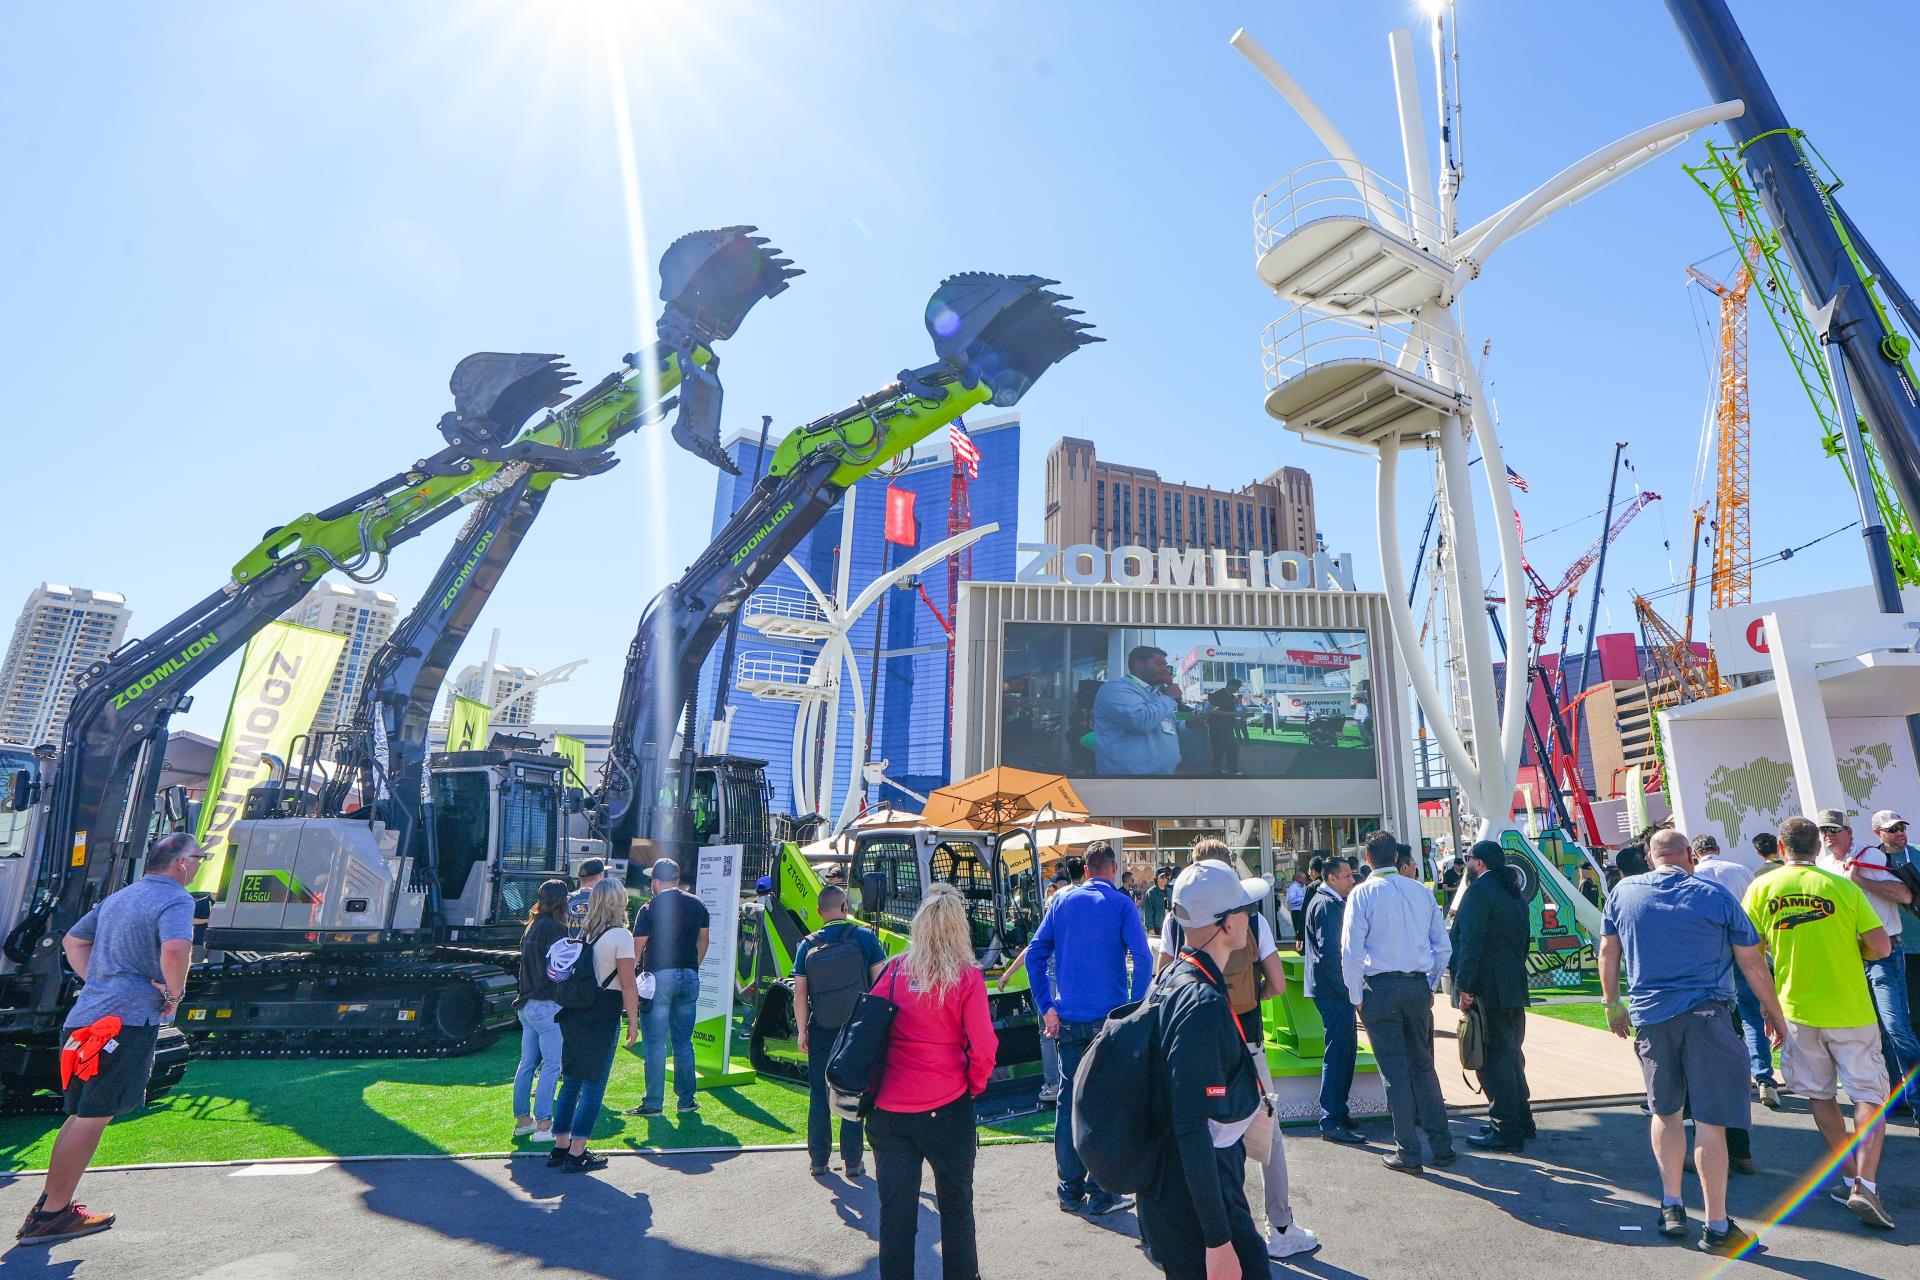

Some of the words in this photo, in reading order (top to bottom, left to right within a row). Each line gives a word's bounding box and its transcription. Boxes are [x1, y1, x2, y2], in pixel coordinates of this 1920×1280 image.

[730, 500, 794, 567] ZOOMLION
[440, 530, 494, 610] ZOOMLION
[1018, 543, 1356, 592] ZOOMLION
[111, 632, 219, 710] ZOOMLION
[244, 891, 271, 902] 145GU
[245, 876, 262, 891] ZE
[787, 863, 808, 899] ZT120V
[1542, 909, 1559, 929] 5
